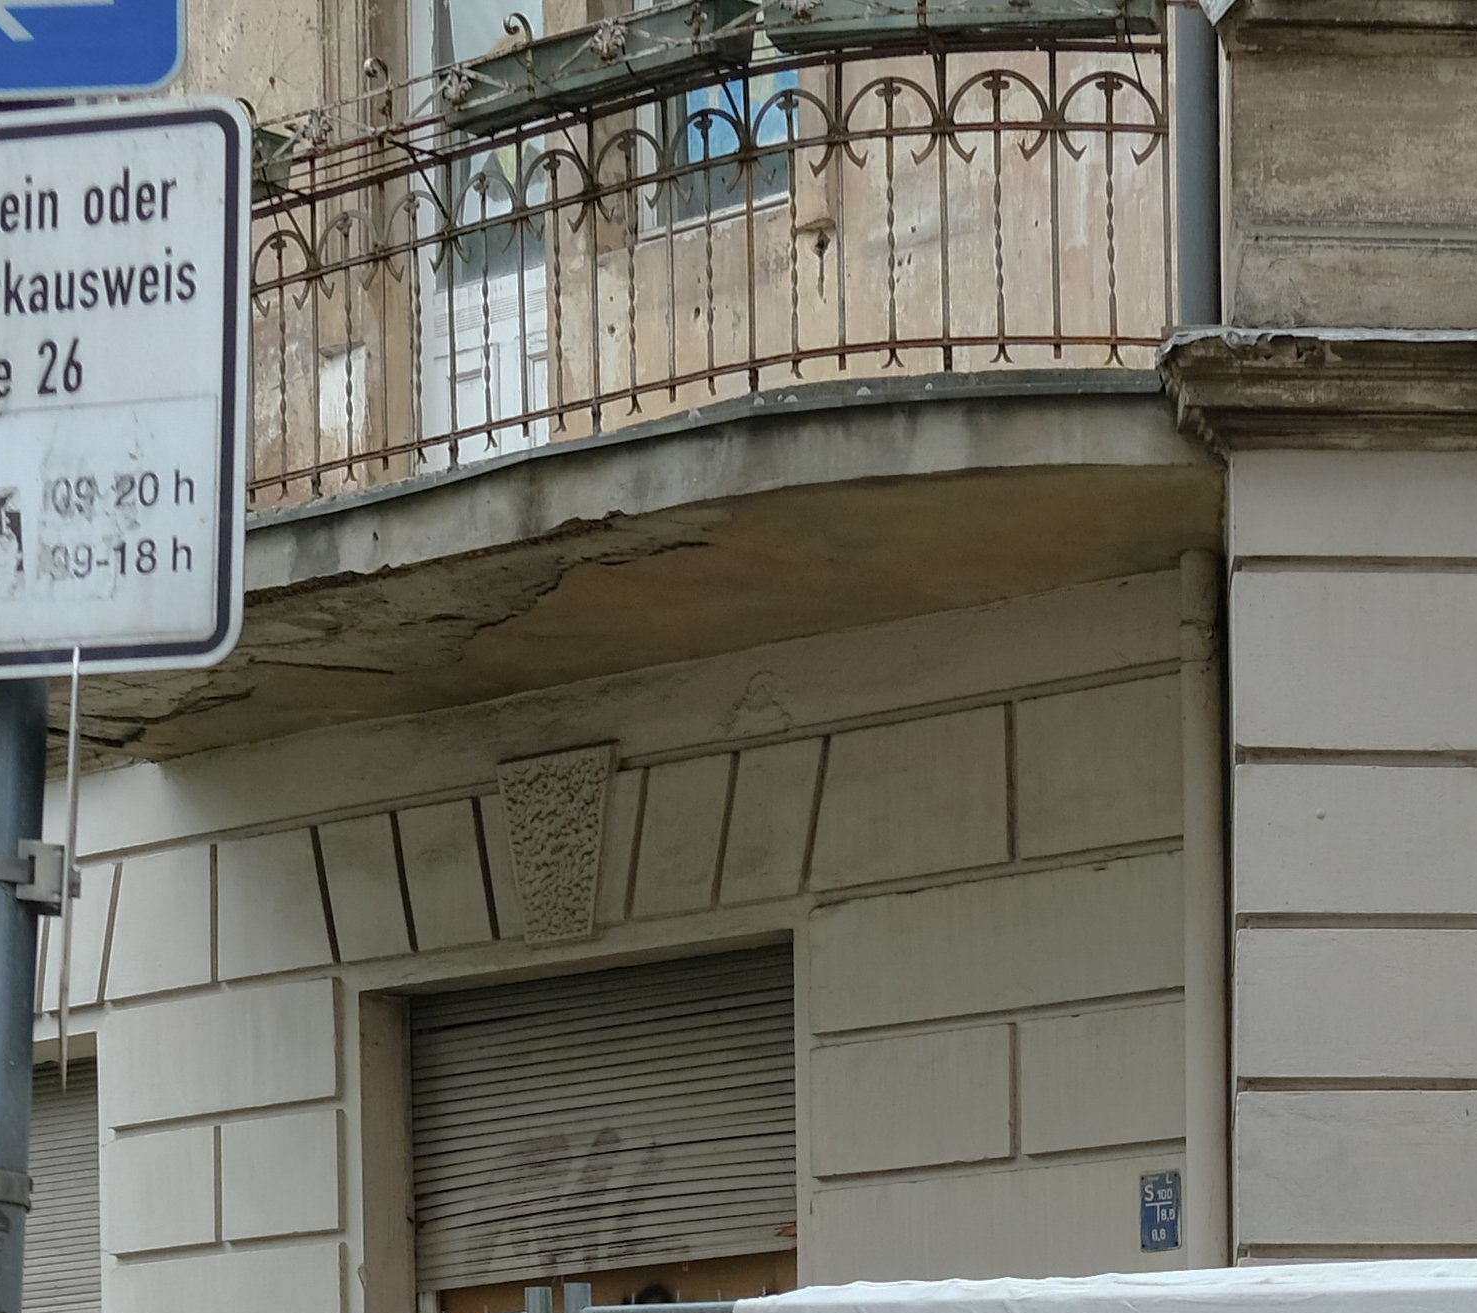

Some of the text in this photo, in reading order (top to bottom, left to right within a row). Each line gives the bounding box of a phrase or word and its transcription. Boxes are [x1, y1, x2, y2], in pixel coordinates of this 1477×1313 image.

[83, 167, 178, 225] oder
[36, 338, 83, 395] 26
[173, 472, 195, 505] h
[172, 535, 192, 573] h
